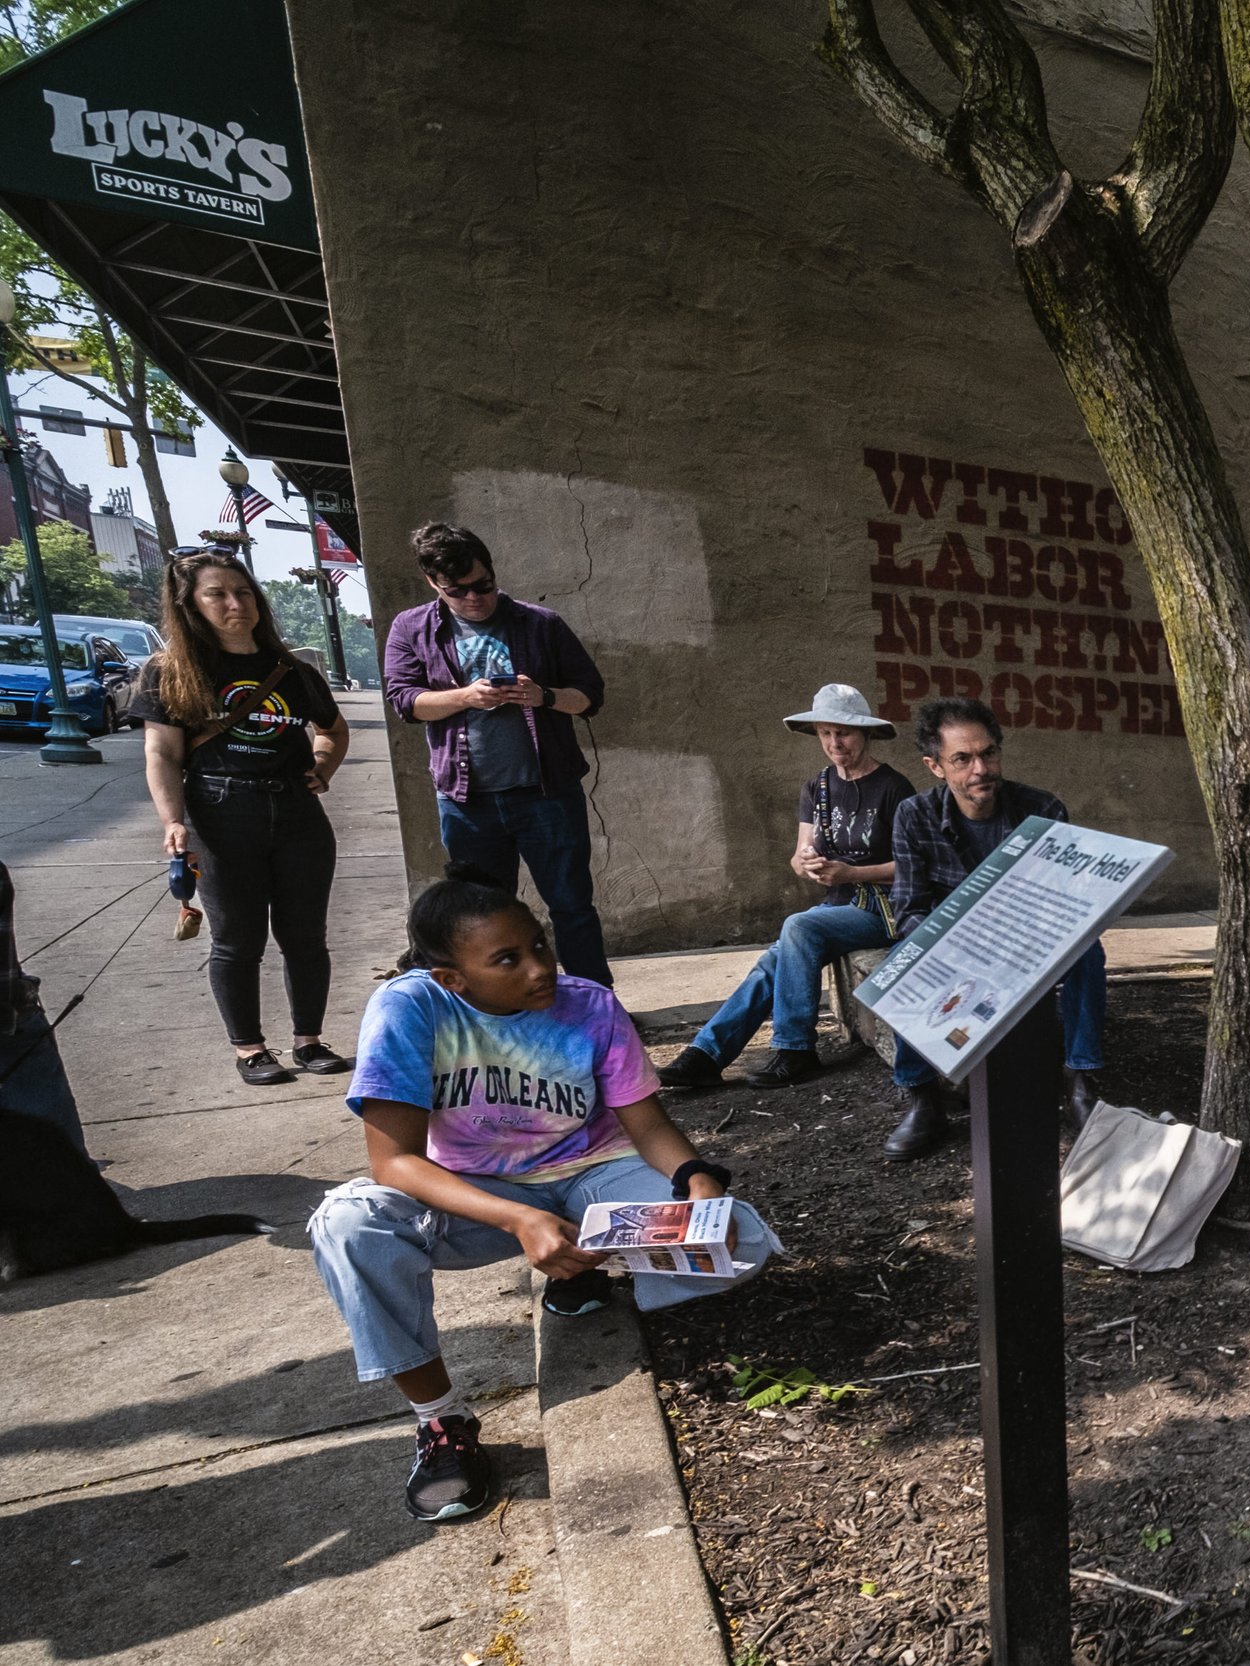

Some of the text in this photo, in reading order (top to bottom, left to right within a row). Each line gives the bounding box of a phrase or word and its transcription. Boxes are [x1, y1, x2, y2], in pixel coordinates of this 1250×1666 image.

[43, 89, 292, 202] LUCKY'S
[101, 172, 259, 217] SPORTS TAVERN
[864, 448, 1134, 545] WITHO
[867, 521, 1132, 611] LABOR
[871, 592, 1173, 674] NOTHIN
[205, 712, 303, 726] JUEENTH
[1033, 837, 1142, 884] The Berry Hotel
[432, 1066, 479, 1110] EW
